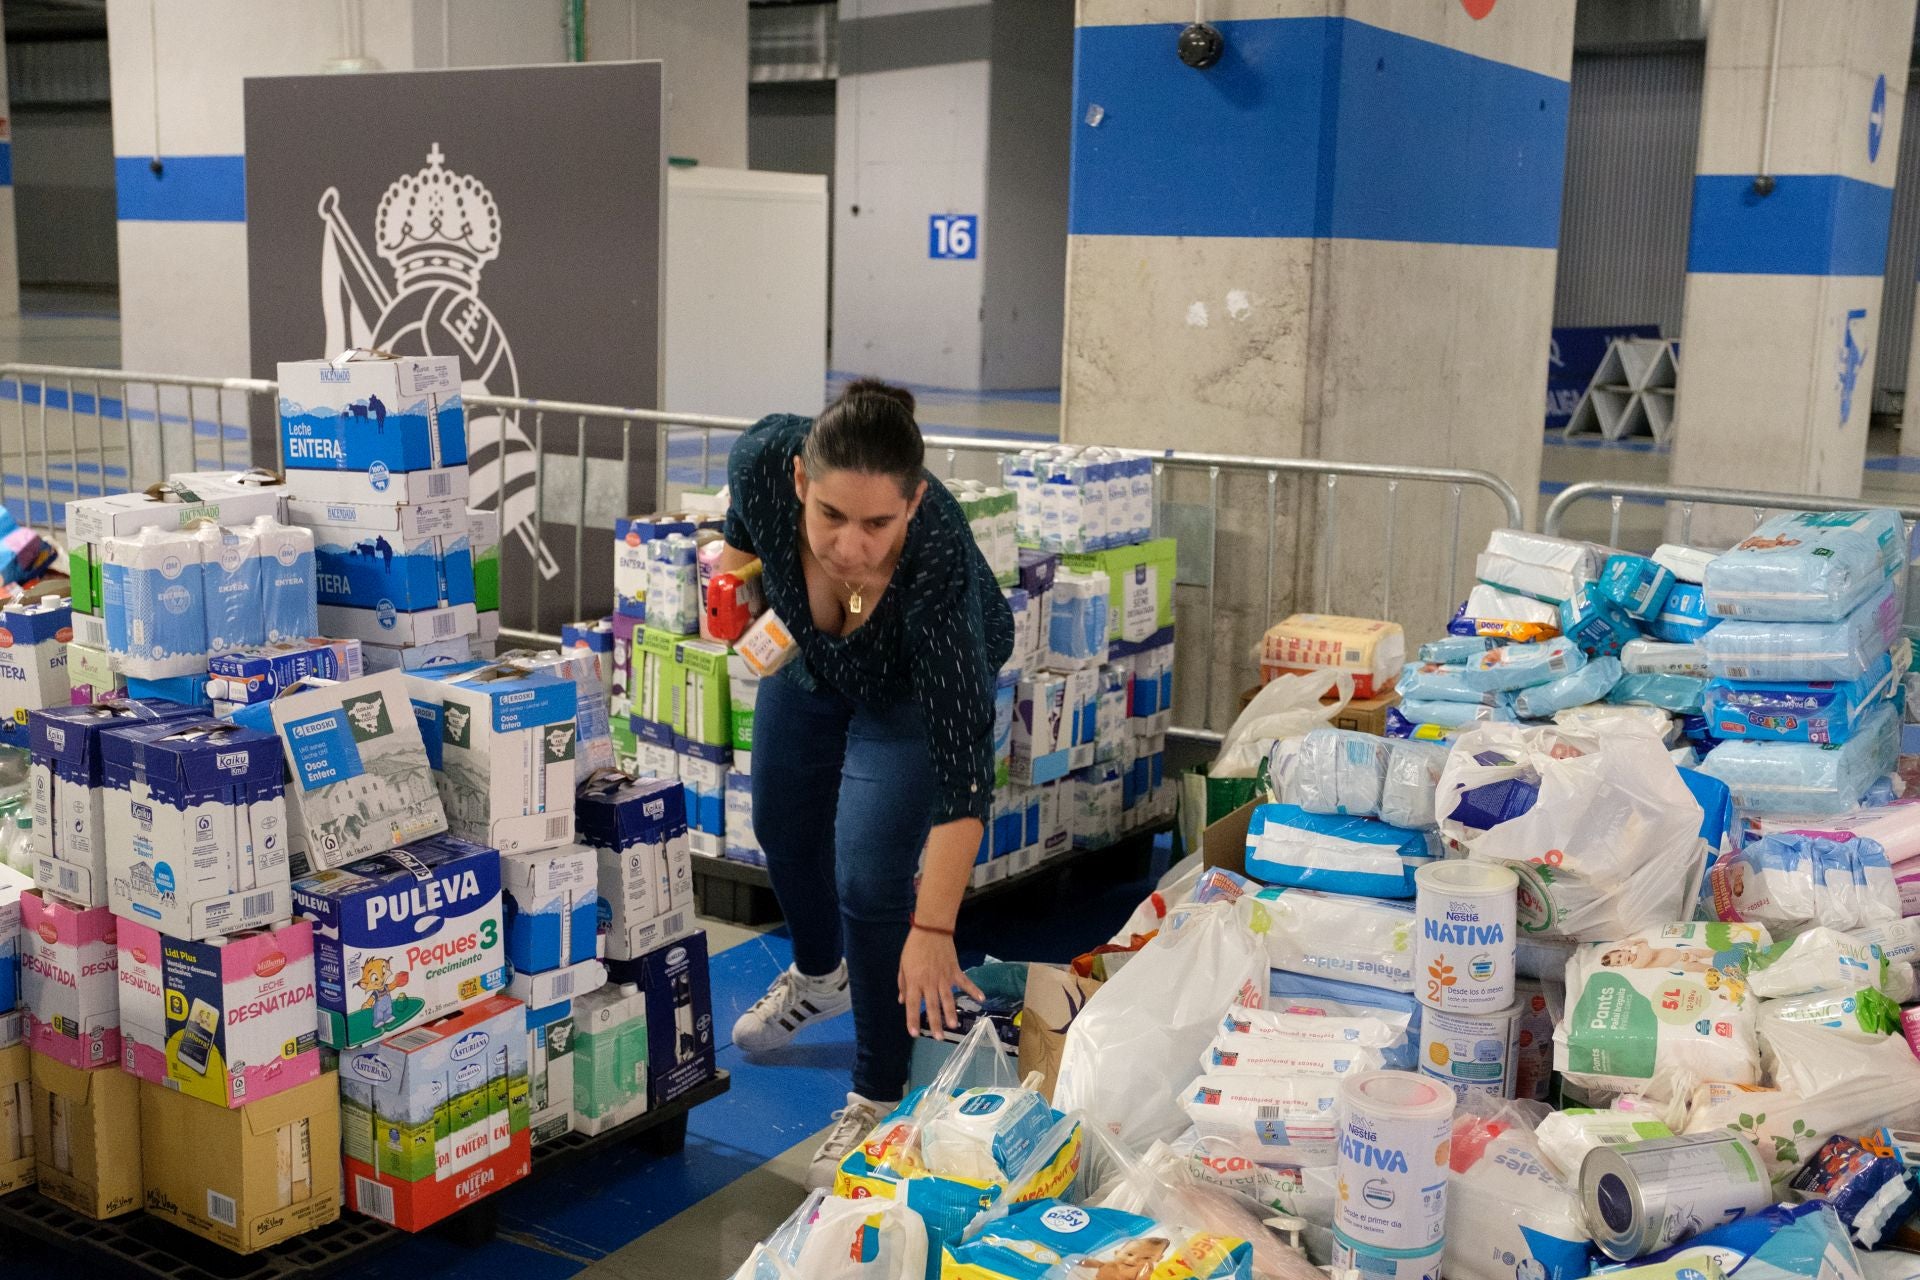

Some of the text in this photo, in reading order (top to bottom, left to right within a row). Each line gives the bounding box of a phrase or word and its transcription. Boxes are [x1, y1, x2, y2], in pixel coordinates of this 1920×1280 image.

[934, 219, 972, 255] 16
[320, 369, 350, 383] HACENDADO
[288, 422, 312, 437] Leche
[290, 437, 342, 460] ENTERA
[327, 507, 356, 520] HACENDADO
[316, 573, 351, 594] TERA
[50, 655, 67, 669] ENT
[0, 665, 26, 681] TERA
[510, 692, 532, 703] EROSKI
[306, 719, 335, 733] EROSKI
[501, 714, 517, 722] Osoa
[501, 721, 521, 730] Entera
[48, 729, 65, 742] Kaiku
[220, 754, 247, 767] Kaiku
[305, 760, 328, 772] Osoa
[308, 768, 336, 782] Entera
[292, 889, 331, 914] PULEVA
[366, 869, 480, 931] PULEVA
[1424, 916, 1504, 946] NATIVA
[40, 946, 57, 960] LECHE
[406, 918, 499, 971] Peques 3
[165, 948, 197, 963] Lidl Plus
[22, 953, 77, 989] DESNATADA
[82, 962, 118, 978] DESNA
[1357, 960, 1411, 980] Pañales
[120, 970, 161, 998] DESNATADA
[258, 978, 285, 994] LECHE
[1427, 980, 1440, 1002] 2
[1448, 987, 1468, 995] Desde
[228, 983, 314, 1026] DESNATADA
[1591, 987, 1614, 1029] Pants
[1611, 1013, 1620, 1030] Pañal
[453, 1038, 487, 1058] ASTURIANA
[1592, 1048, 1600, 1072] Pants
[355, 1059, 389, 1080] ASTURIANA
[494, 1123, 510, 1141] ENT
[1349, 1124, 1377, 1142] Nestlé
[456, 1135, 488, 1159] ENTERA
[1493, 1154, 1553, 1184] ñales
[456, 1168, 495, 1199] ENTERA
[1367, 1215, 1389, 1229] primer
